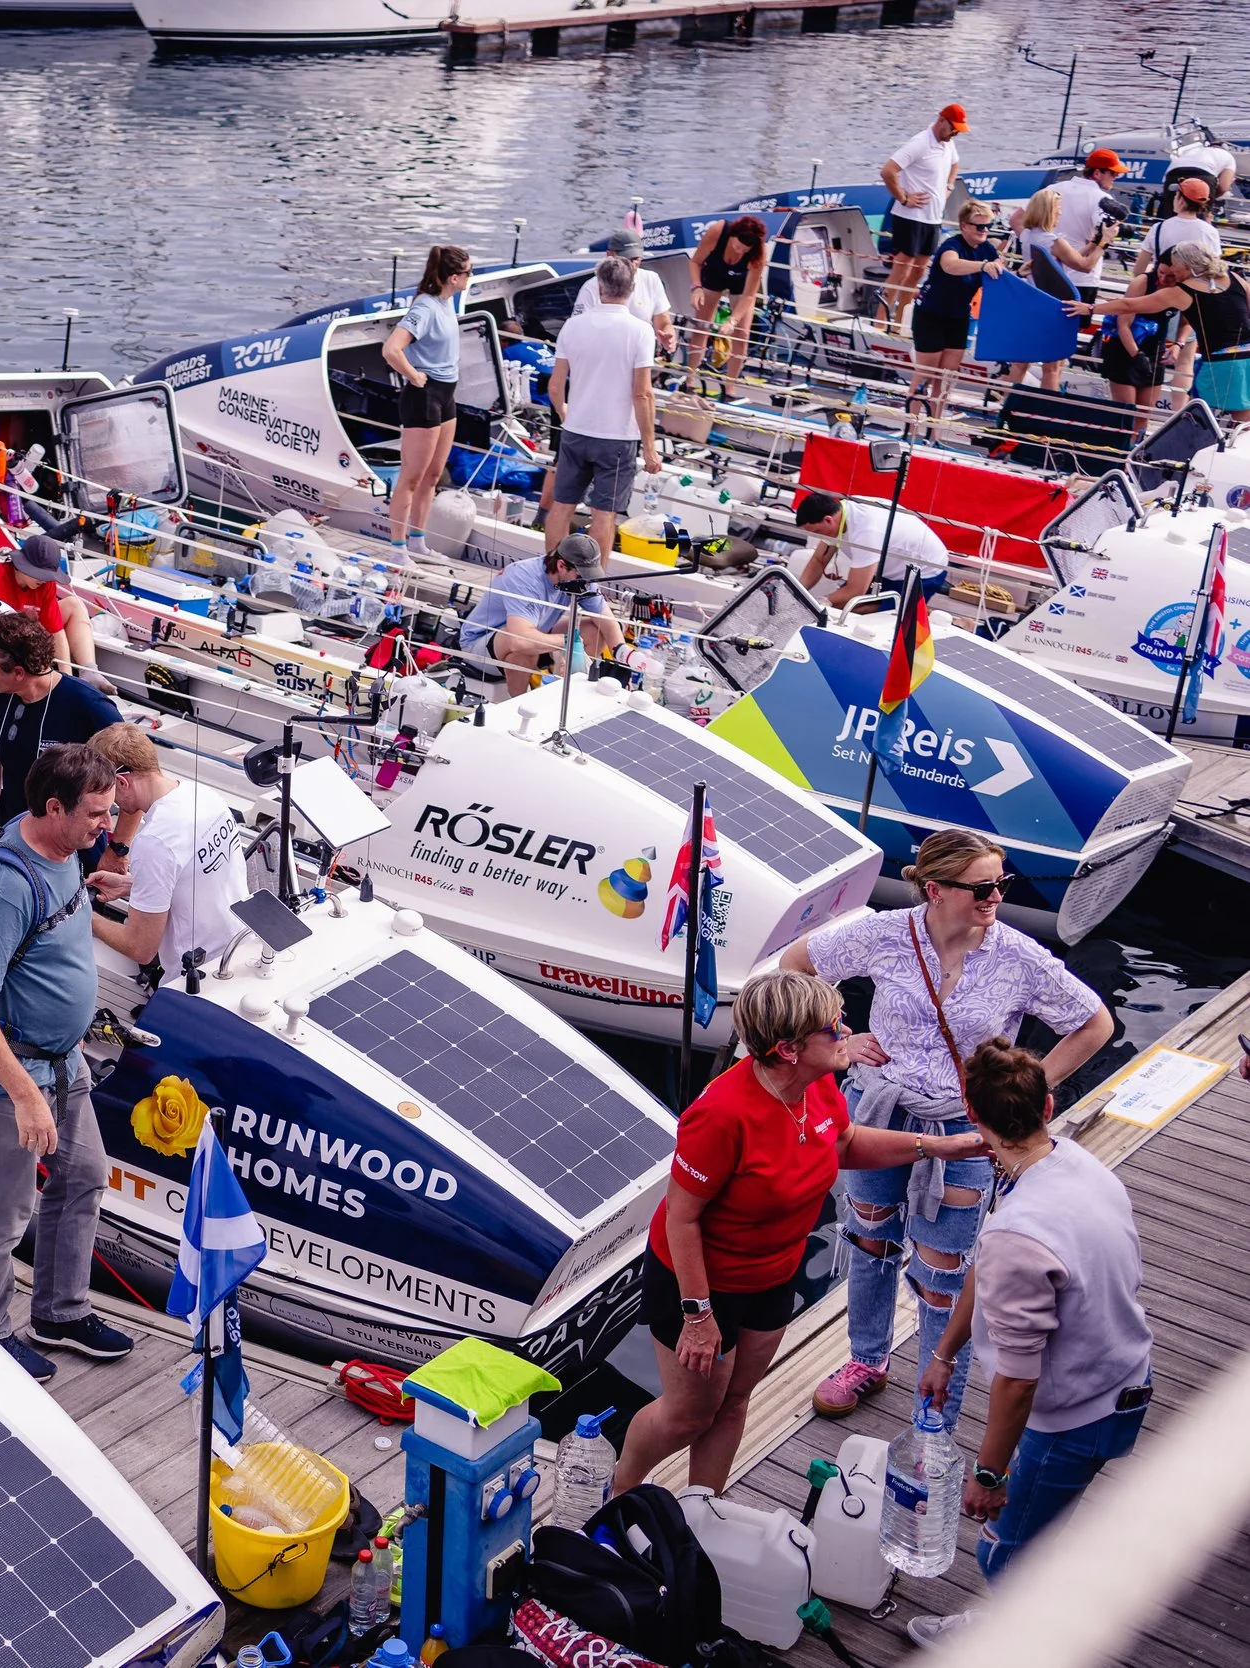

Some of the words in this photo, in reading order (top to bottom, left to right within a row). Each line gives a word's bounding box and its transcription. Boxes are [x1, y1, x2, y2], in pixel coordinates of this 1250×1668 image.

[963, 176, 999, 195] OW
[1120, 160, 1148, 180] OW
[165, 353, 208, 378] WORLD'S
[231, 336, 292, 370] ROW
[219, 385, 270, 414] MARINE
[218, 400, 321, 443] CONSERVATION
[265, 429, 320, 456] SOCIETY
[1024, 634, 1075, 653] RANNOCH
[1075, 645, 1093, 657] R45
[1138, 641, 1175, 659] GRAND
[1153, 639, 1165, 648] The
[835, 703, 881, 743] JP
[831, 744, 855, 762] Set
[413, 802, 597, 876] RÖSLER
[357, 856, 414, 881] RANNOCH
[414, 873, 433, 886] R45
[433, 878, 456, 892] Elite
[410, 840, 466, 875] finding
[468, 861, 479, 874] a
[483, 858, 533, 888] better
[535, 878, 569, 901] way
[538, 960, 685, 1011] travellunc
[231, 1104, 458, 1201] RUNWOOD
[227, 1146, 367, 1218] HOMES
[572, 1254, 597, 1278] MATT
[594, 1224, 636, 1263] HAMPSON
[346, 1326, 373, 1342] STU
